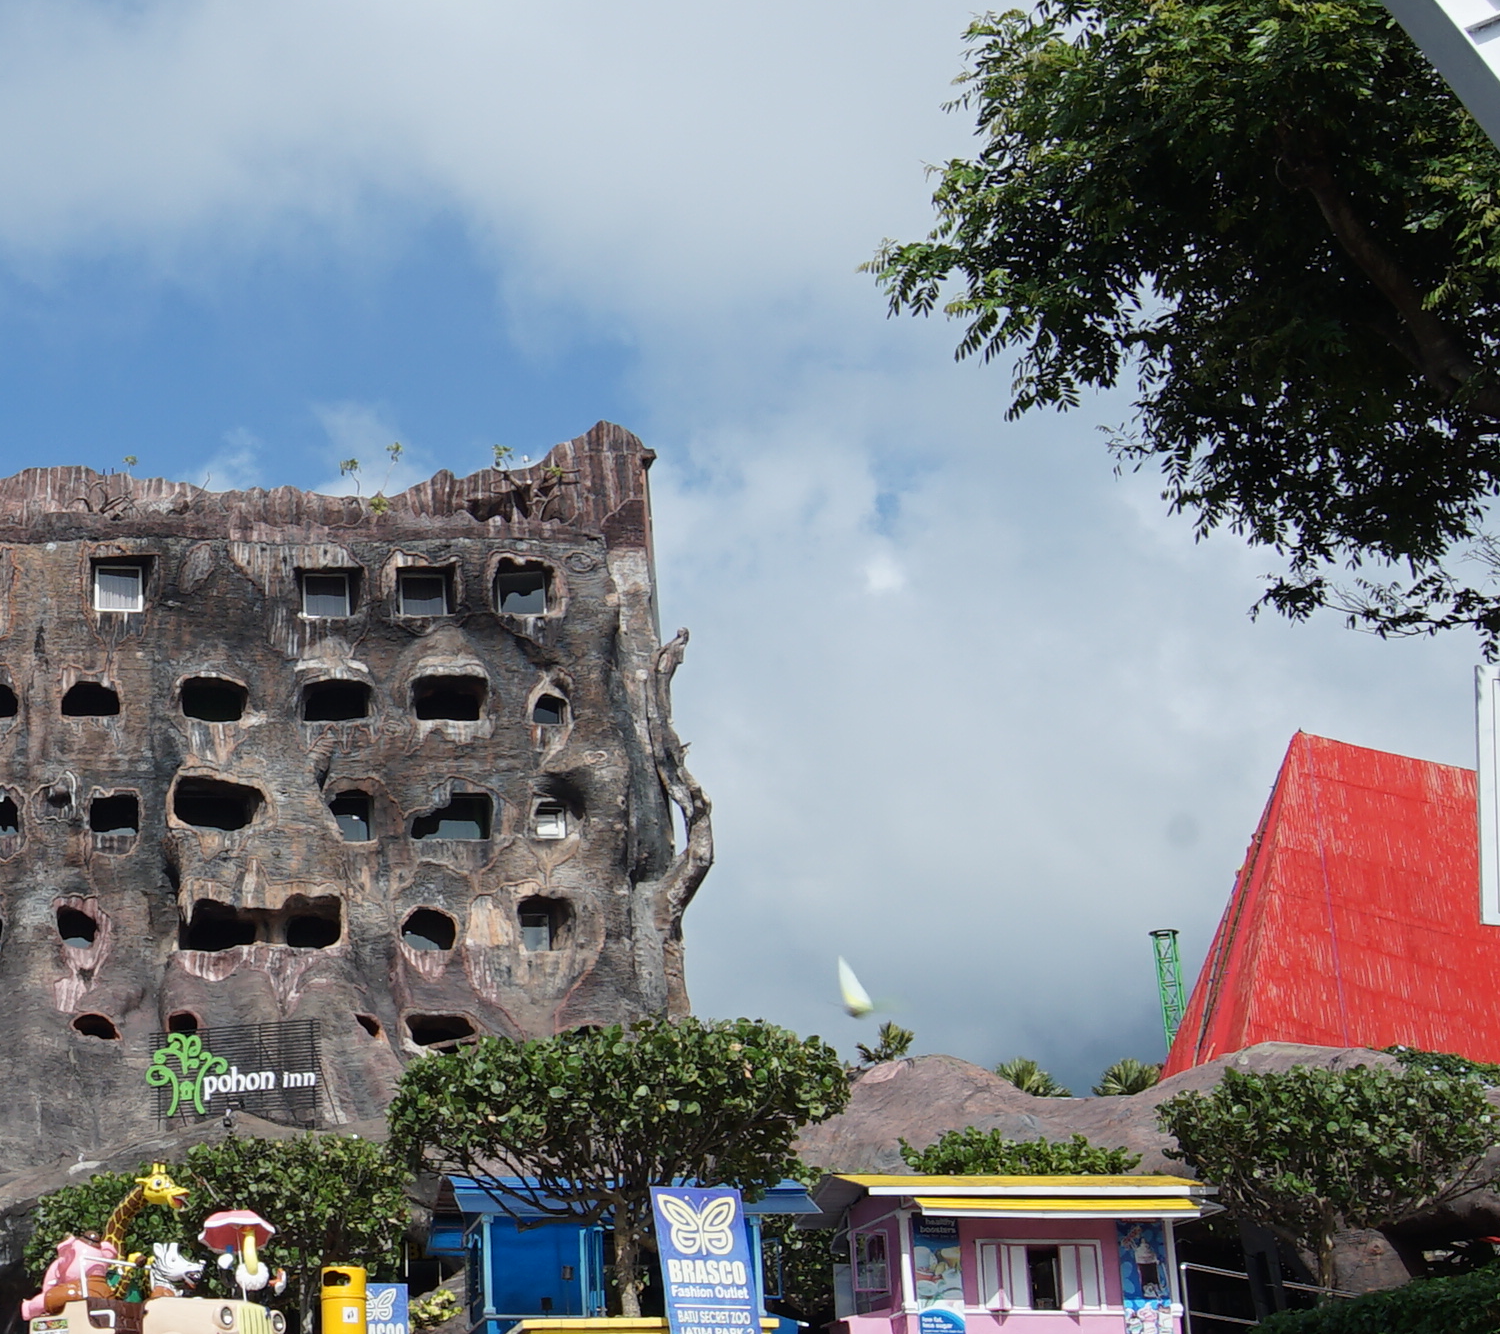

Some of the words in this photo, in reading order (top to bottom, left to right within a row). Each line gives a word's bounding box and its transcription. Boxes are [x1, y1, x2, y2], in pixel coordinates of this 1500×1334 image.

[203, 1066, 276, 1101] pohon
[283, 1071, 316, 1088] inn
[667, 1259, 747, 1285] BRASCO
[671, 1285, 713, 1298] Fashion
[715, 1286, 750, 1299] Outlet
[677, 1310, 698, 1323] BATU
[730, 1311, 751, 1324] ZOO
